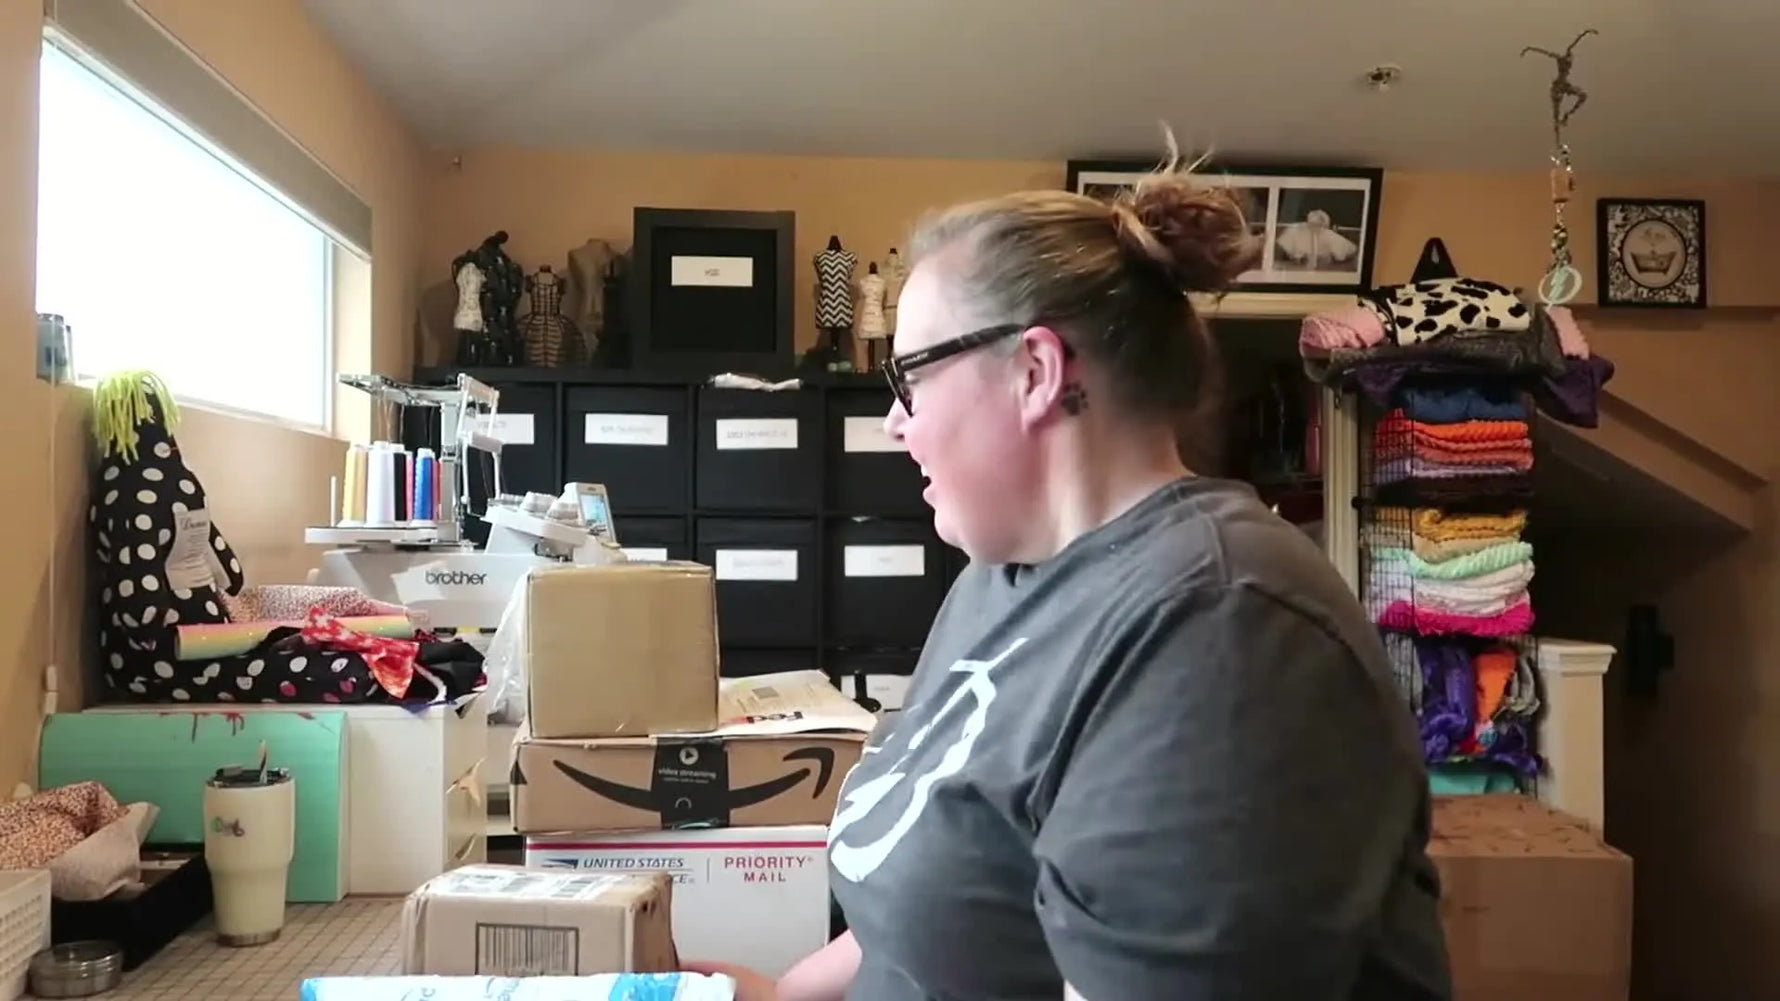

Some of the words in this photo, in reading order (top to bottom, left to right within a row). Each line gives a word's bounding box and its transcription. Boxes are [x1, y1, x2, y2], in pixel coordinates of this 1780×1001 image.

[425, 570, 487, 585] brother
[583, 857, 634, 869] UNITED
[636, 857, 684, 869] STATES
[743, 872, 787, 882] MAIL
